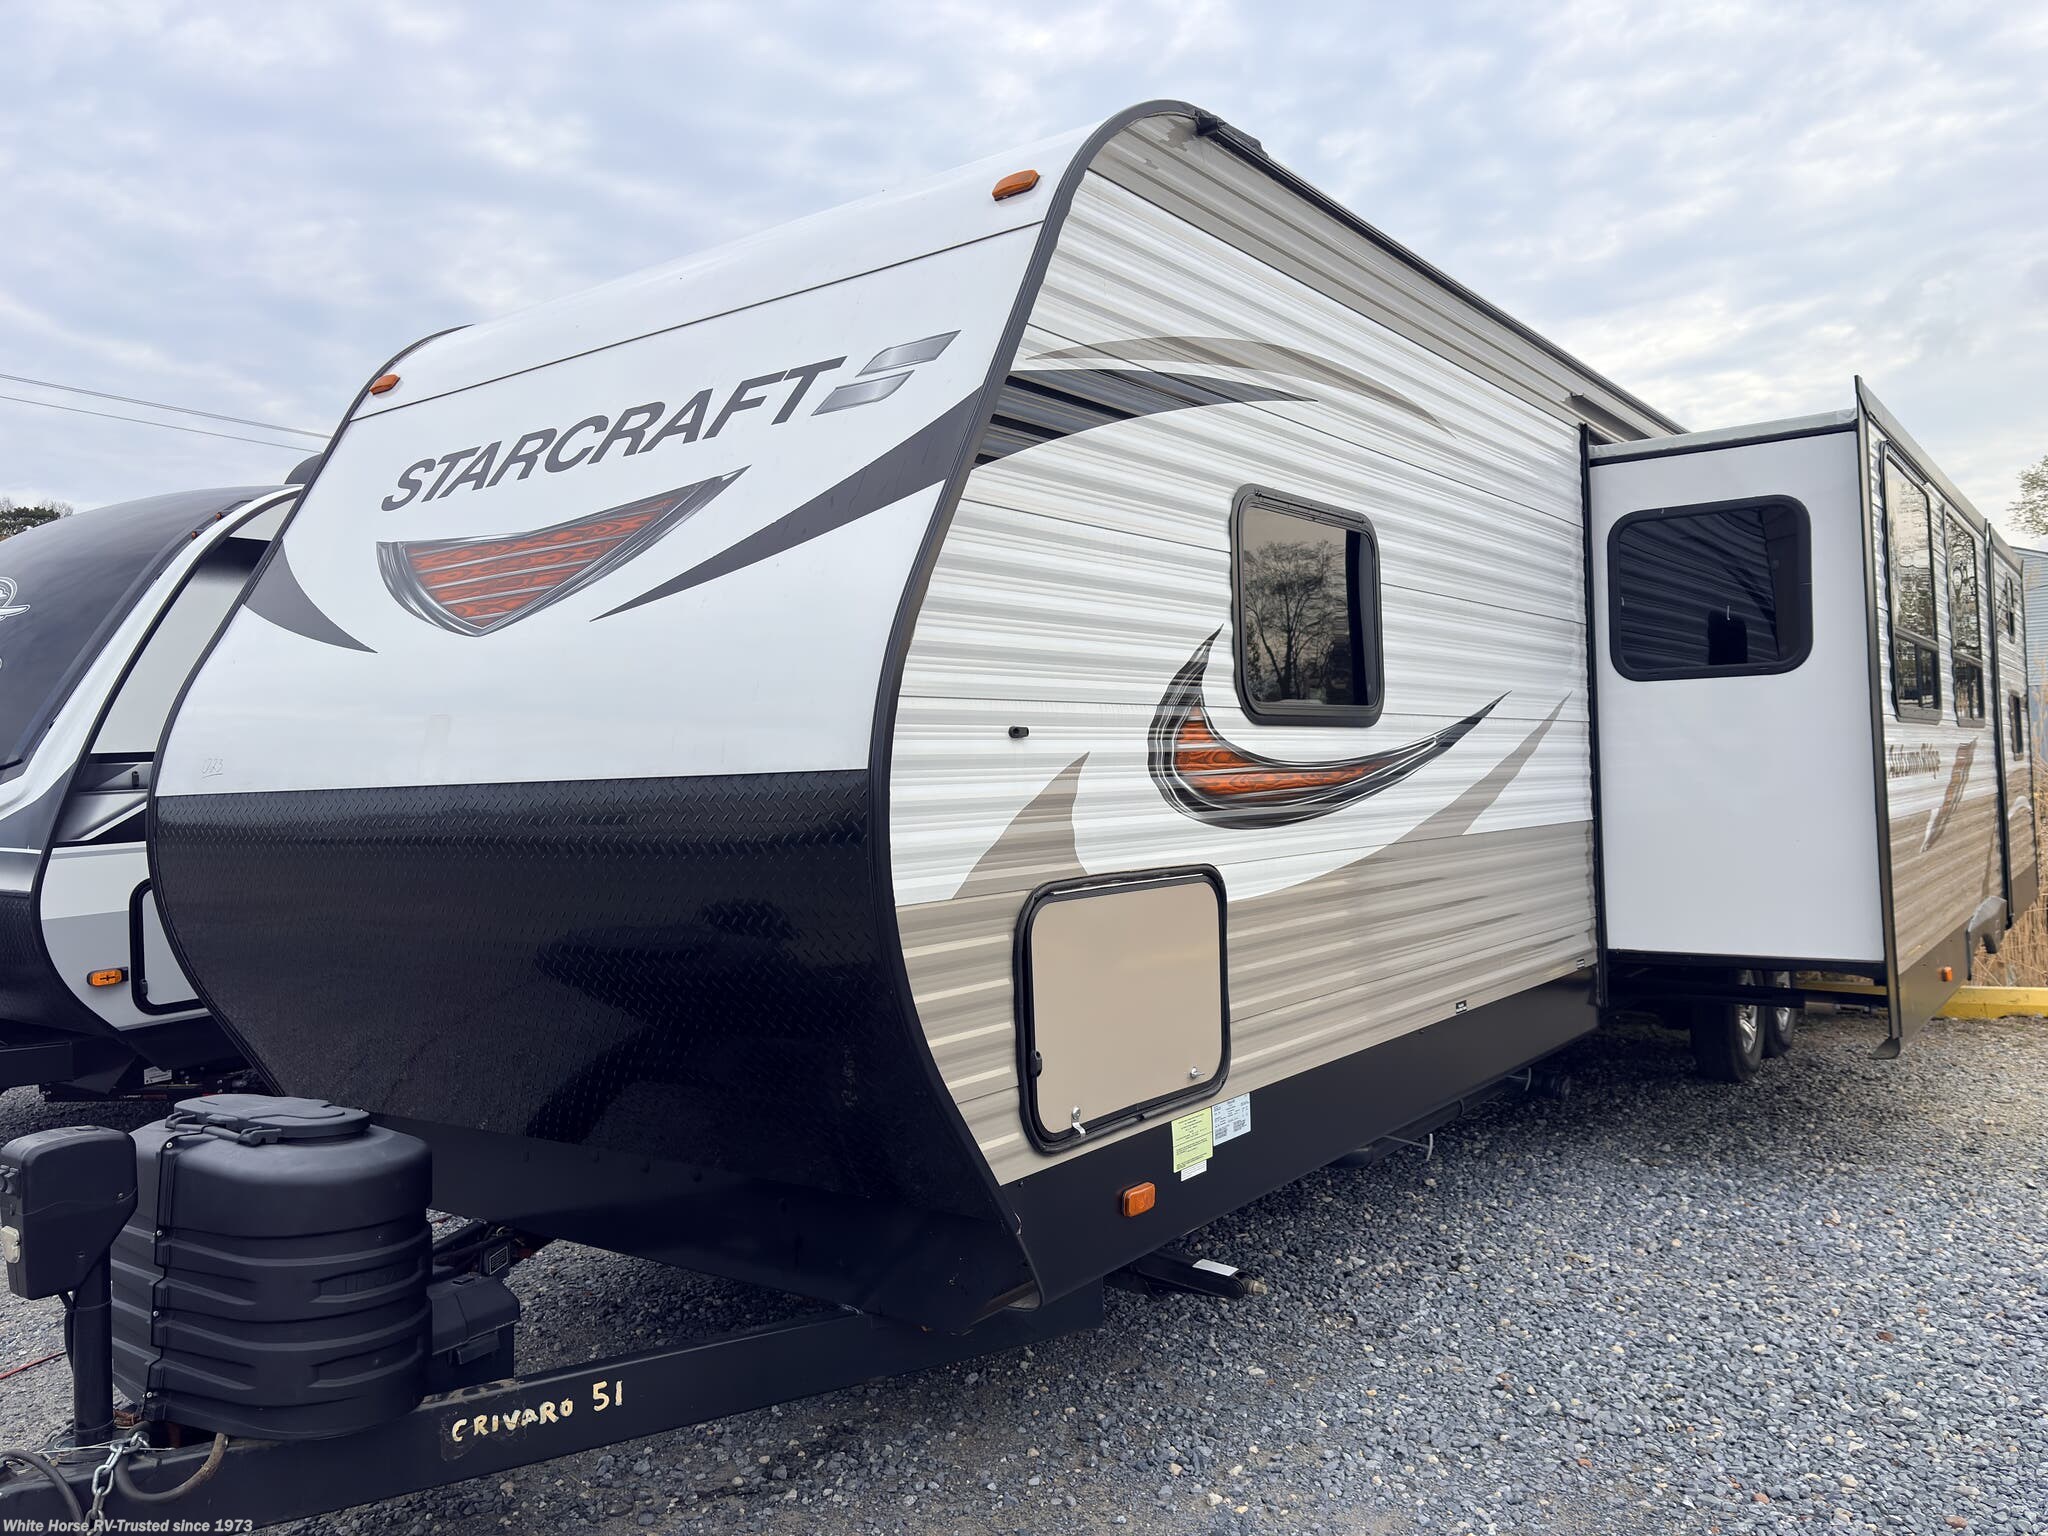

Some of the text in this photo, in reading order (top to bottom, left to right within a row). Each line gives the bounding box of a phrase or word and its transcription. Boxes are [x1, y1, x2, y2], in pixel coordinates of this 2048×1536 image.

[381, 355, 848, 512] STARCRAFT
[451, 1380, 623, 1442] CRIVARO 51
